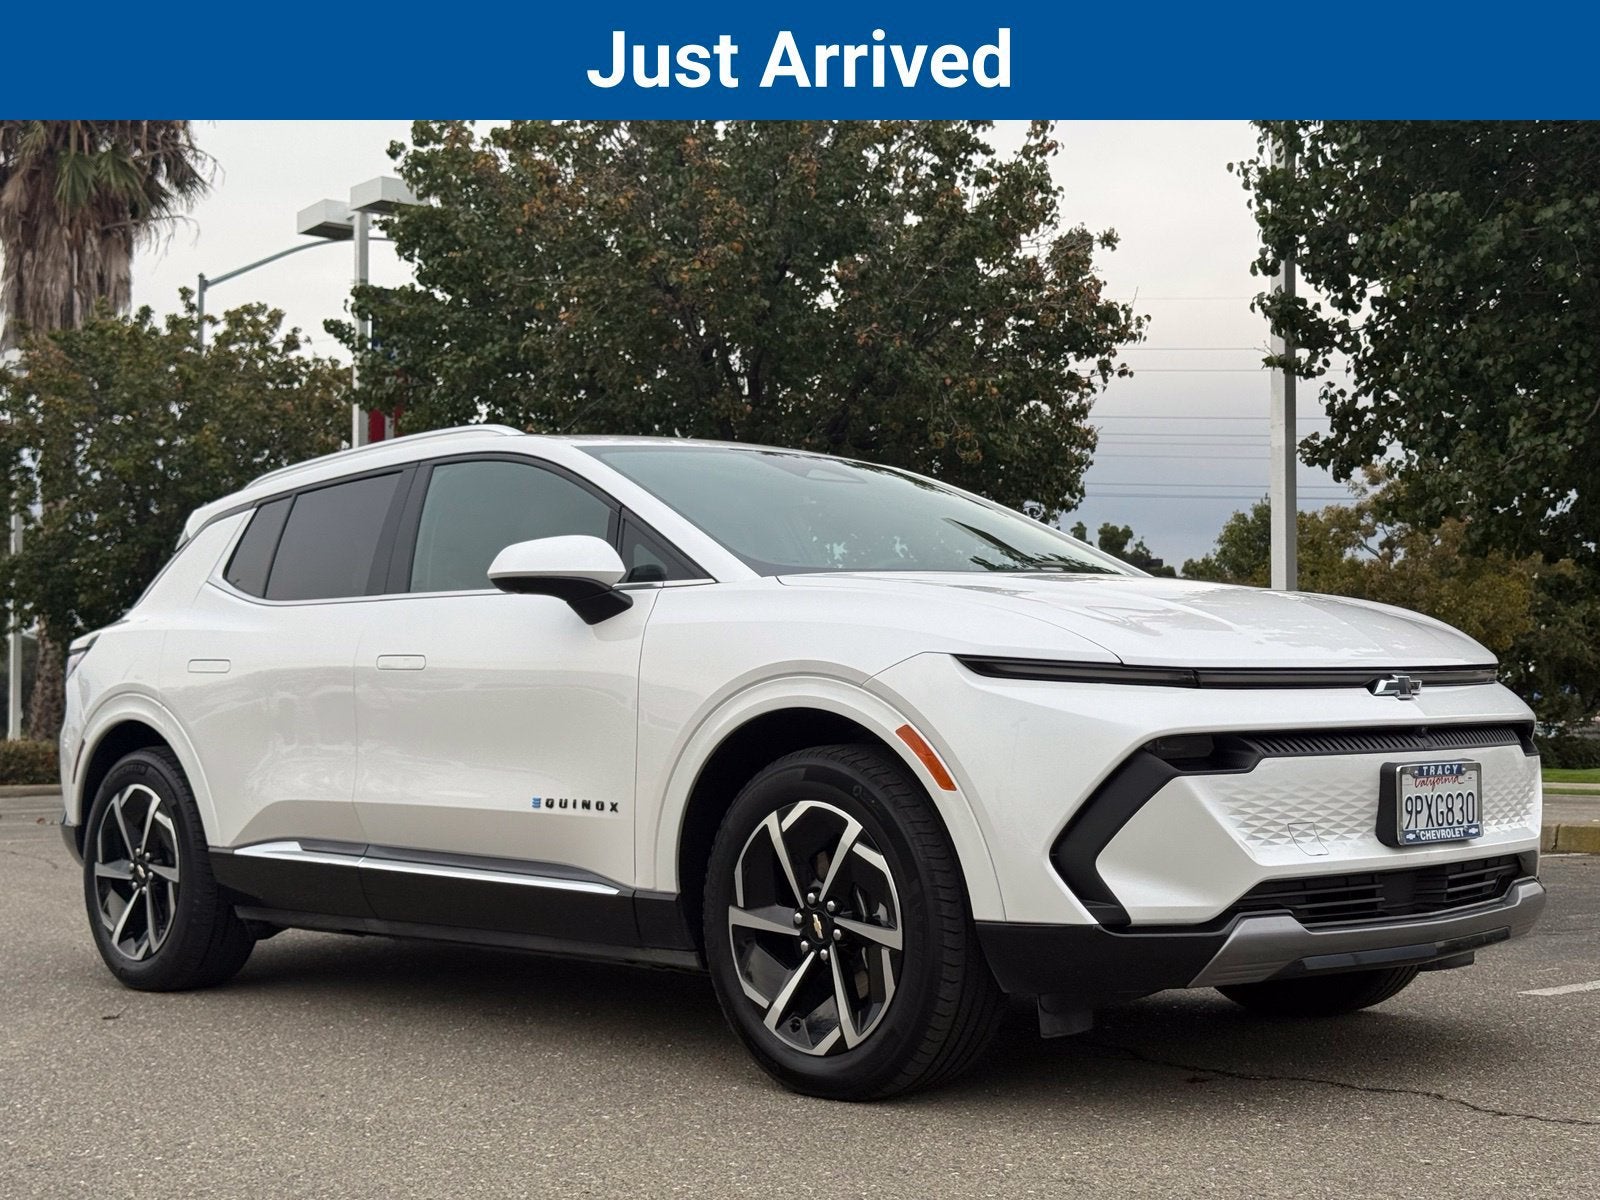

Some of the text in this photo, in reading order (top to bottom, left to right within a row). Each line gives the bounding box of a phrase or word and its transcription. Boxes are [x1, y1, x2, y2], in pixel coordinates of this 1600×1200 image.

[1422, 764, 1458, 776] TRACY
[1414, 776, 1465, 792] California
[532, 797, 619, 812] EQUINOX
[1405, 792, 1475, 829] 9PXG830
[1420, 828, 1465, 841] CHEVROLET
